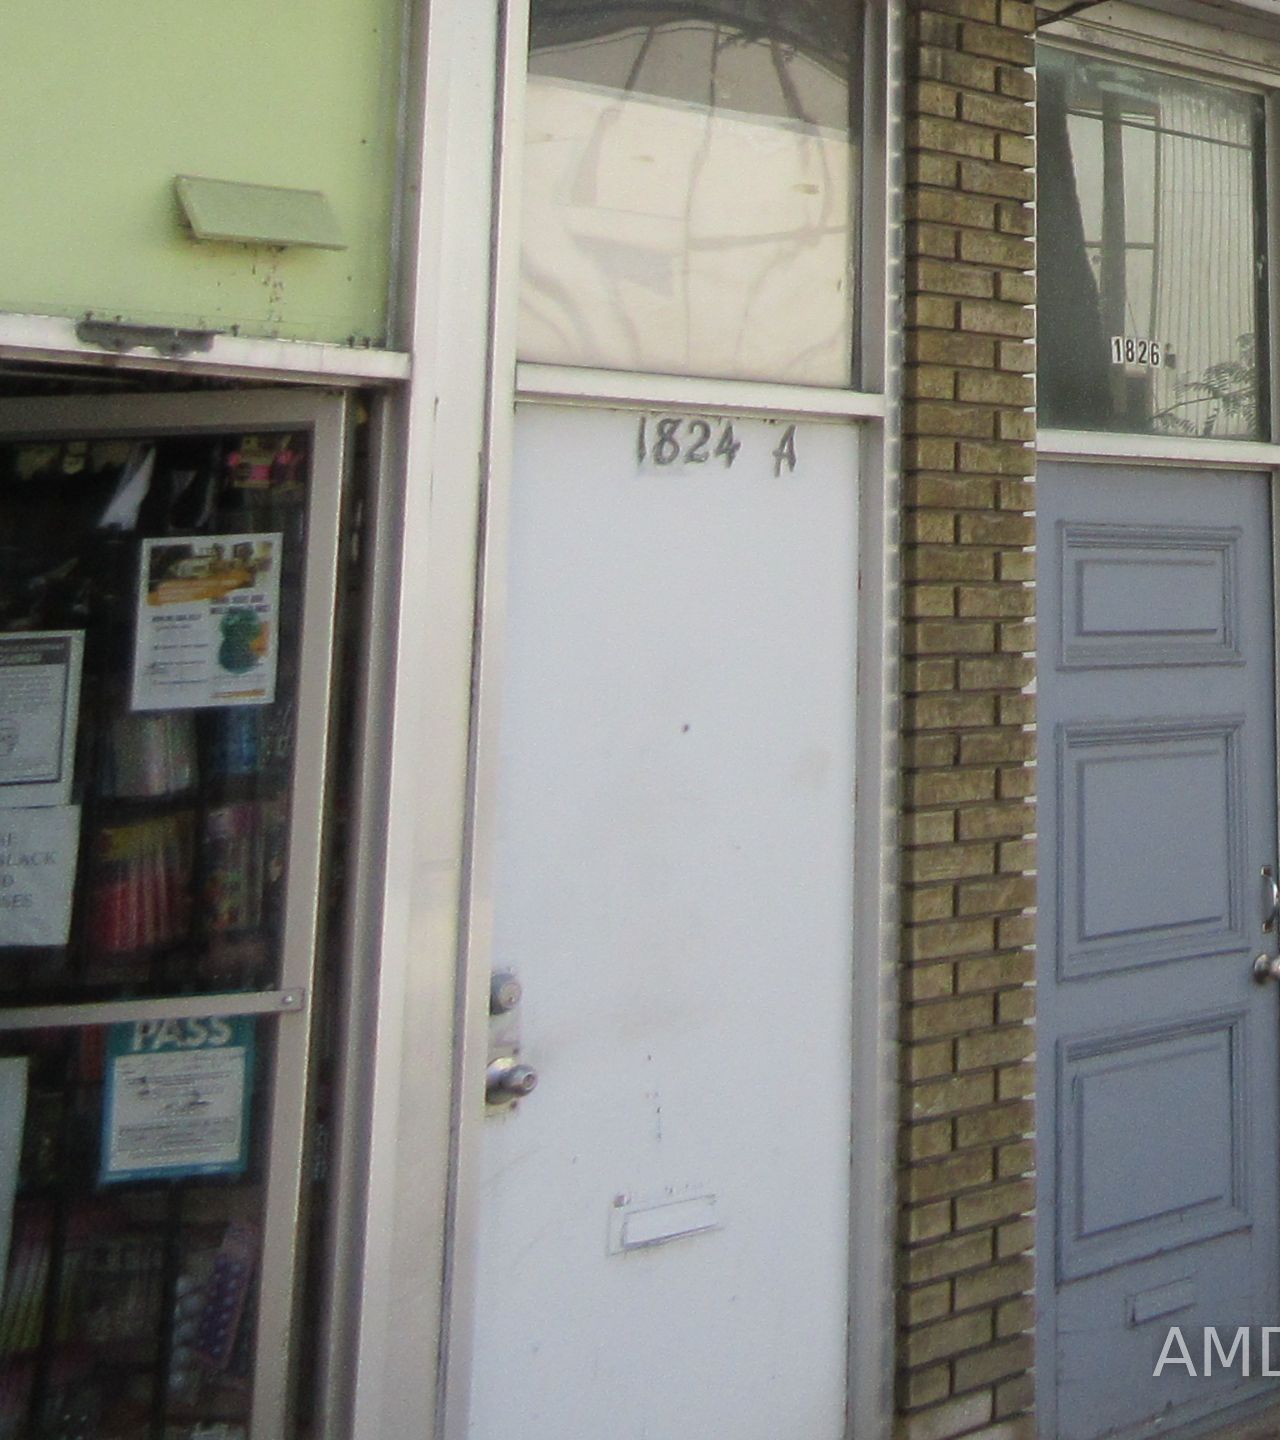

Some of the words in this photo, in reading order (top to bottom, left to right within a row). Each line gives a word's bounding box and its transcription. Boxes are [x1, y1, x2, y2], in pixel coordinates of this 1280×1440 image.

[1114, 338, 1160, 366] 1826
[635, 416, 741, 471] 1824
[772, 425, 798, 477] A
[132, 1018, 232, 1051] PASS
